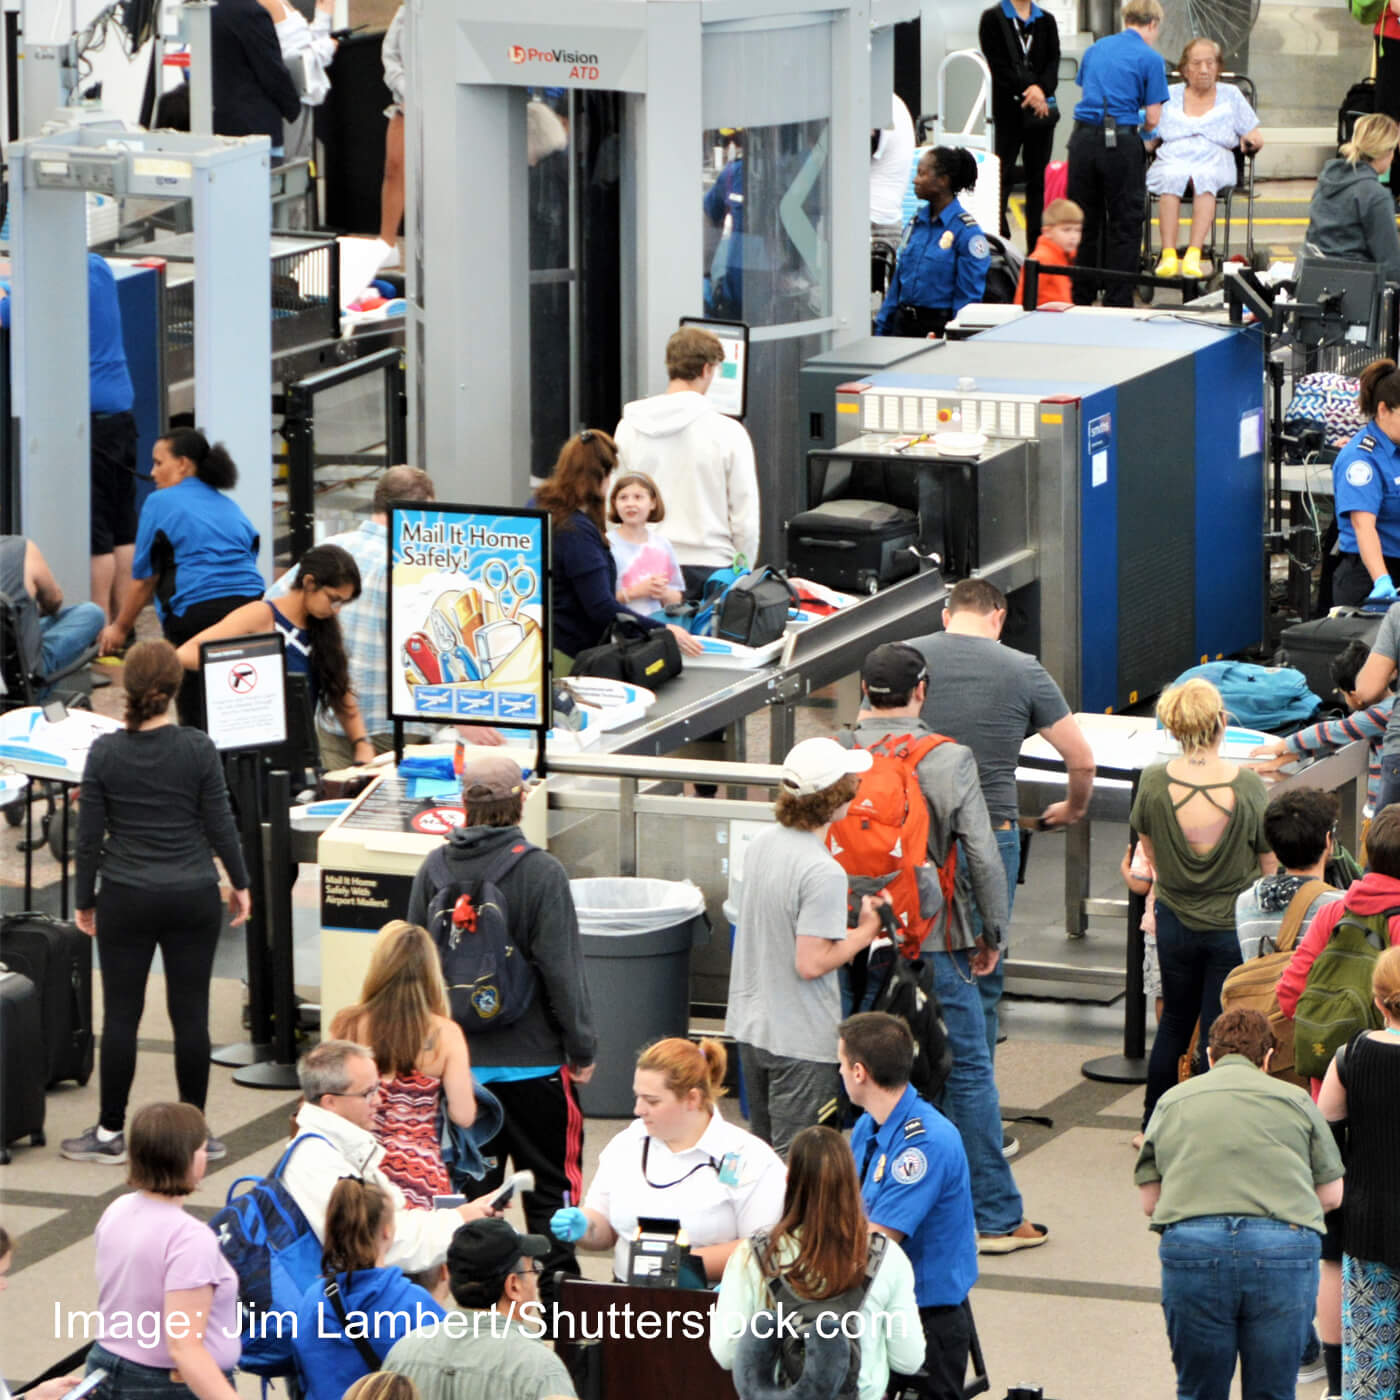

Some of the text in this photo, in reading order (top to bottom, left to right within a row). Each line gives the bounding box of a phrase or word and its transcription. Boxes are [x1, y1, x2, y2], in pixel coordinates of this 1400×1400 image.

[527, 48, 599, 64] ProVision
[568, 65, 600, 80] ATD
[402, 522, 531, 549] Mail It Home
[403, 546, 469, 574] Safely!
